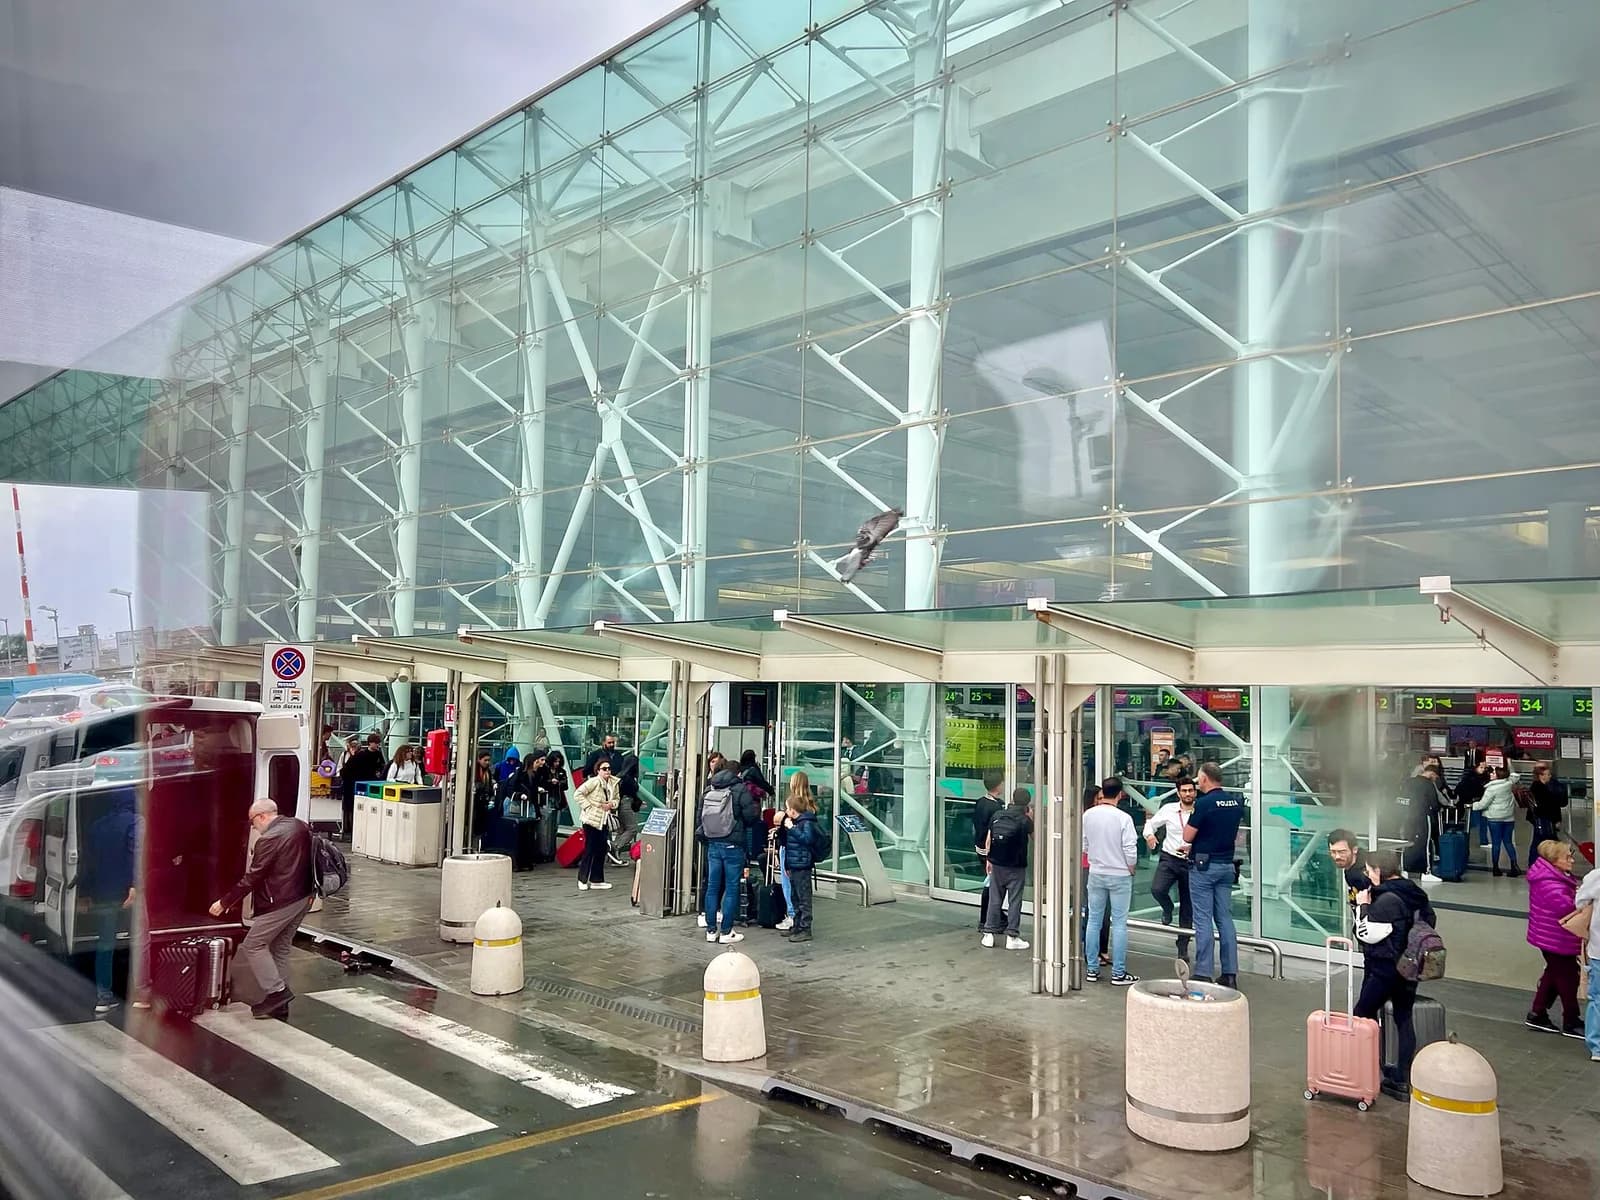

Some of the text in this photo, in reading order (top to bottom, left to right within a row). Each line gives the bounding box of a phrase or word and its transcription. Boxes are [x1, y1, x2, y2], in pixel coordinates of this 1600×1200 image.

[865, 690, 874, 699] 22
[944, 692, 956, 701] 24
[971, 692, 982, 701] 25
[1129, 694, 1142, 705] 28
[1164, 694, 1177, 706] 29
[1416, 697, 1433, 710] 33
[1521, 698, 1543, 712] 34
[1575, 699, 1592, 712] 35
[1516, 731, 1553, 739] Jet2.com
[1215, 799, 1239, 807] POLIZIA
